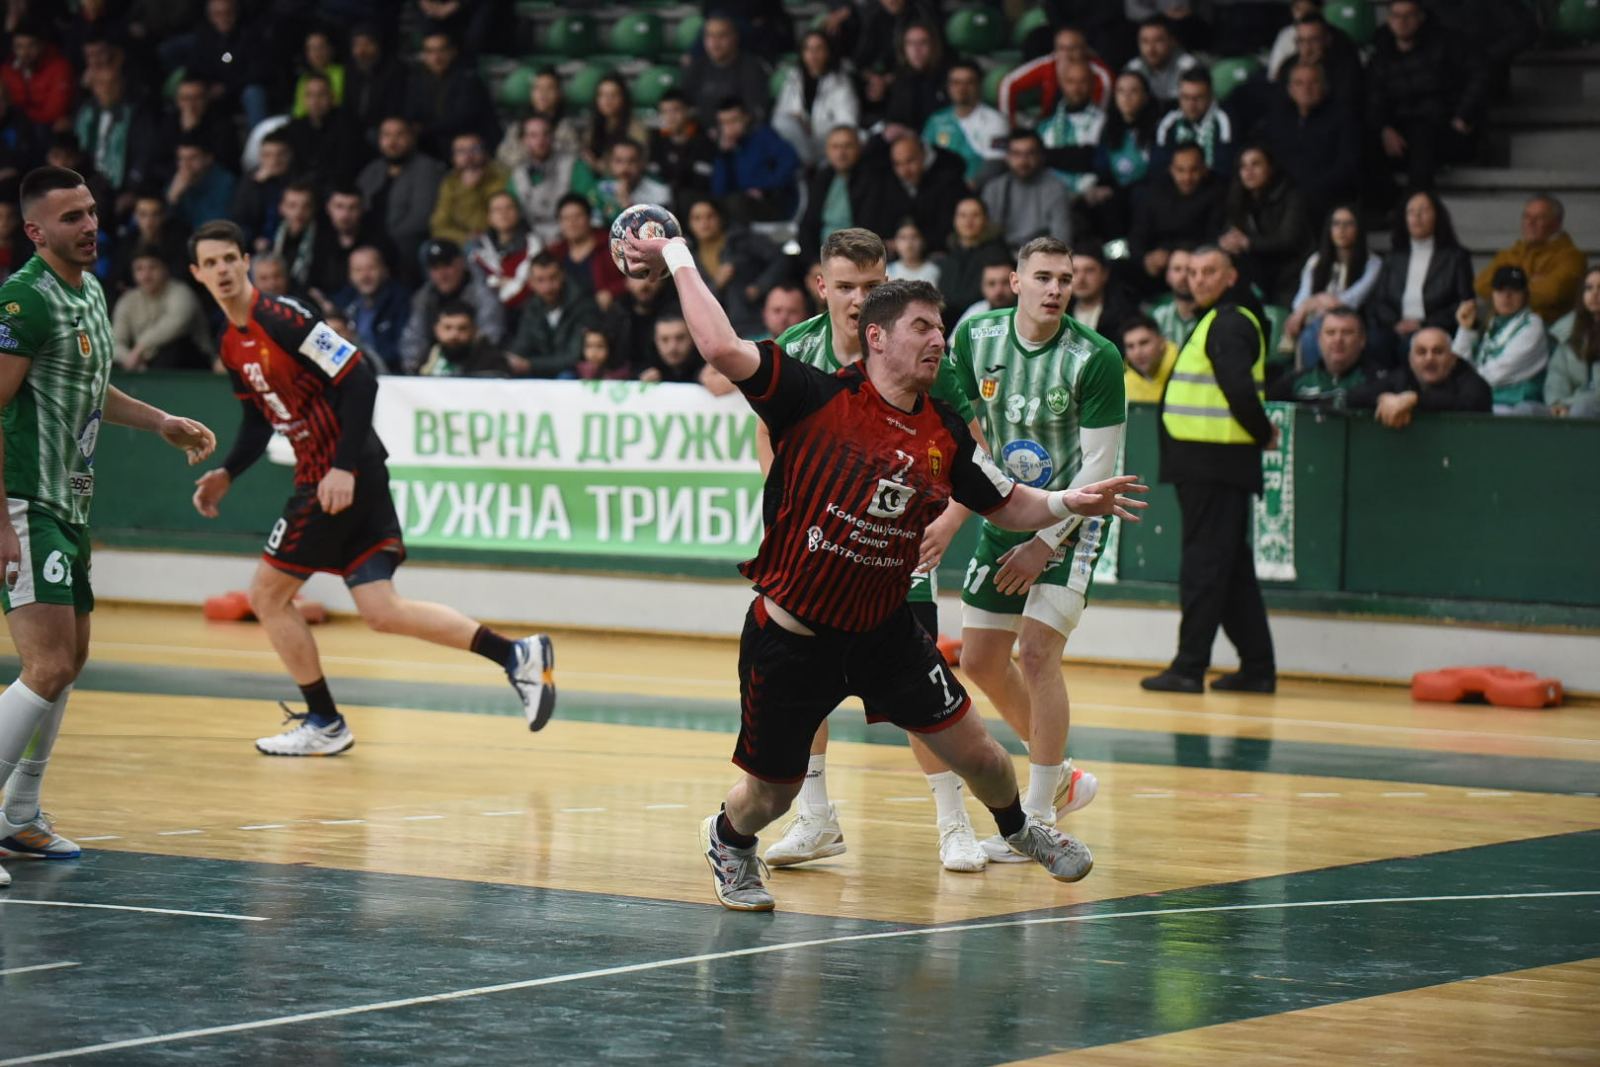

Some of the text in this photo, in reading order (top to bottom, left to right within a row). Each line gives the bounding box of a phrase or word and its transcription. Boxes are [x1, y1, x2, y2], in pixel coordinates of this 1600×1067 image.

[1005, 394, 1040, 426] 31
[414, 409, 758, 463] ВЕРНА ДРУЖИ
[586, 485, 764, 545] ТРИБИ
[928, 664, 955, 707] 7
